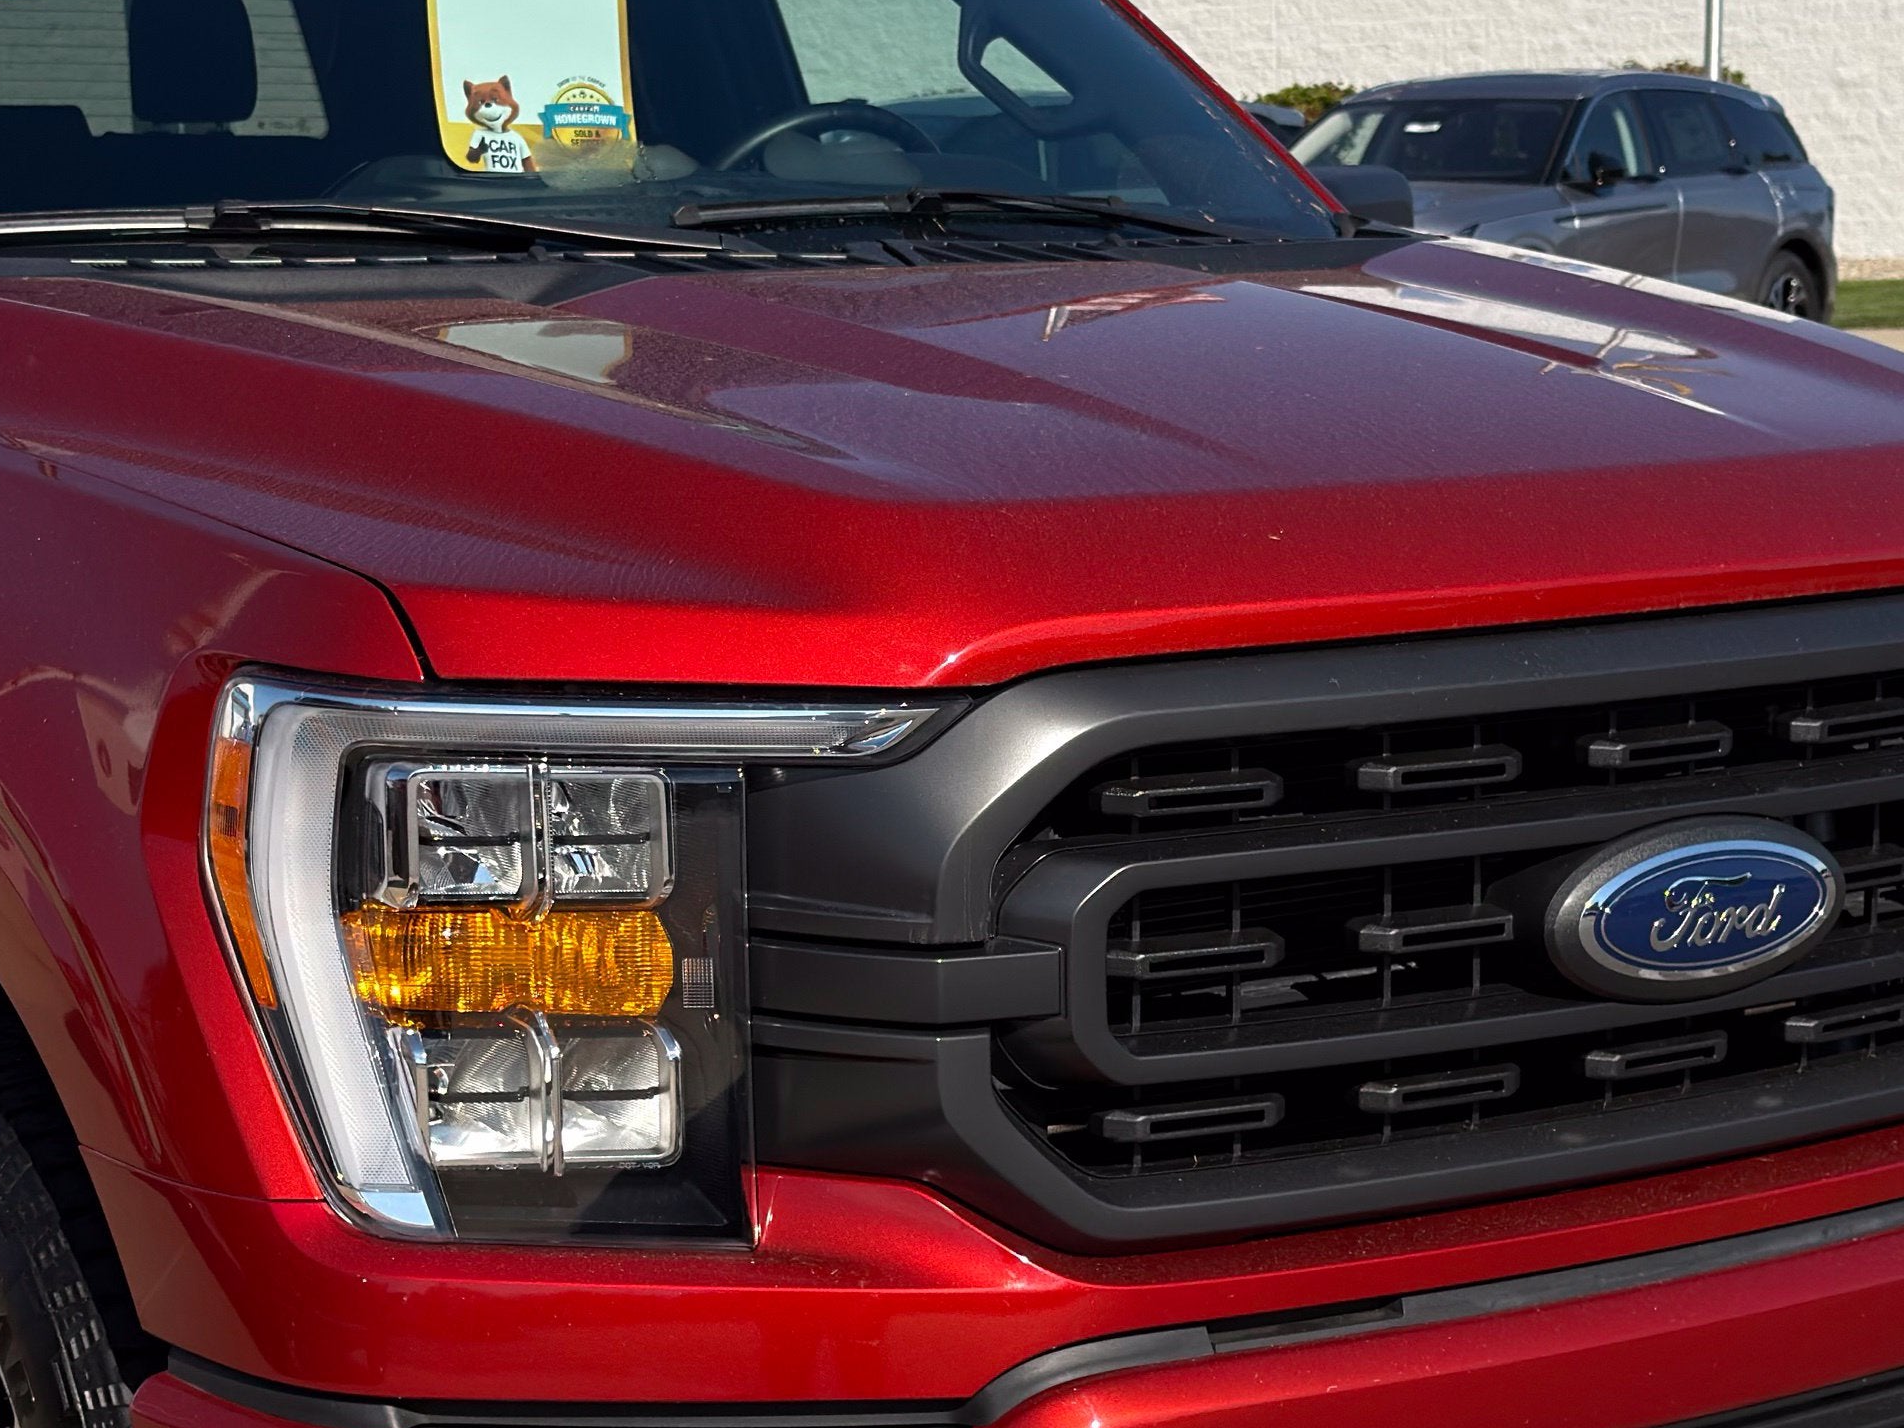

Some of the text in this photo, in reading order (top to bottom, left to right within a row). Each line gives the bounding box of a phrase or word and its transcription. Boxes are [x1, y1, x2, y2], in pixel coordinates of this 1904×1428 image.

[554, 113, 617, 126] HOMEGROWN
[573, 129, 592, 138] SOLD
[488, 139, 517, 154] CAR
[490, 154, 518, 171] FOX
[1648, 871, 1786, 954] Ford
